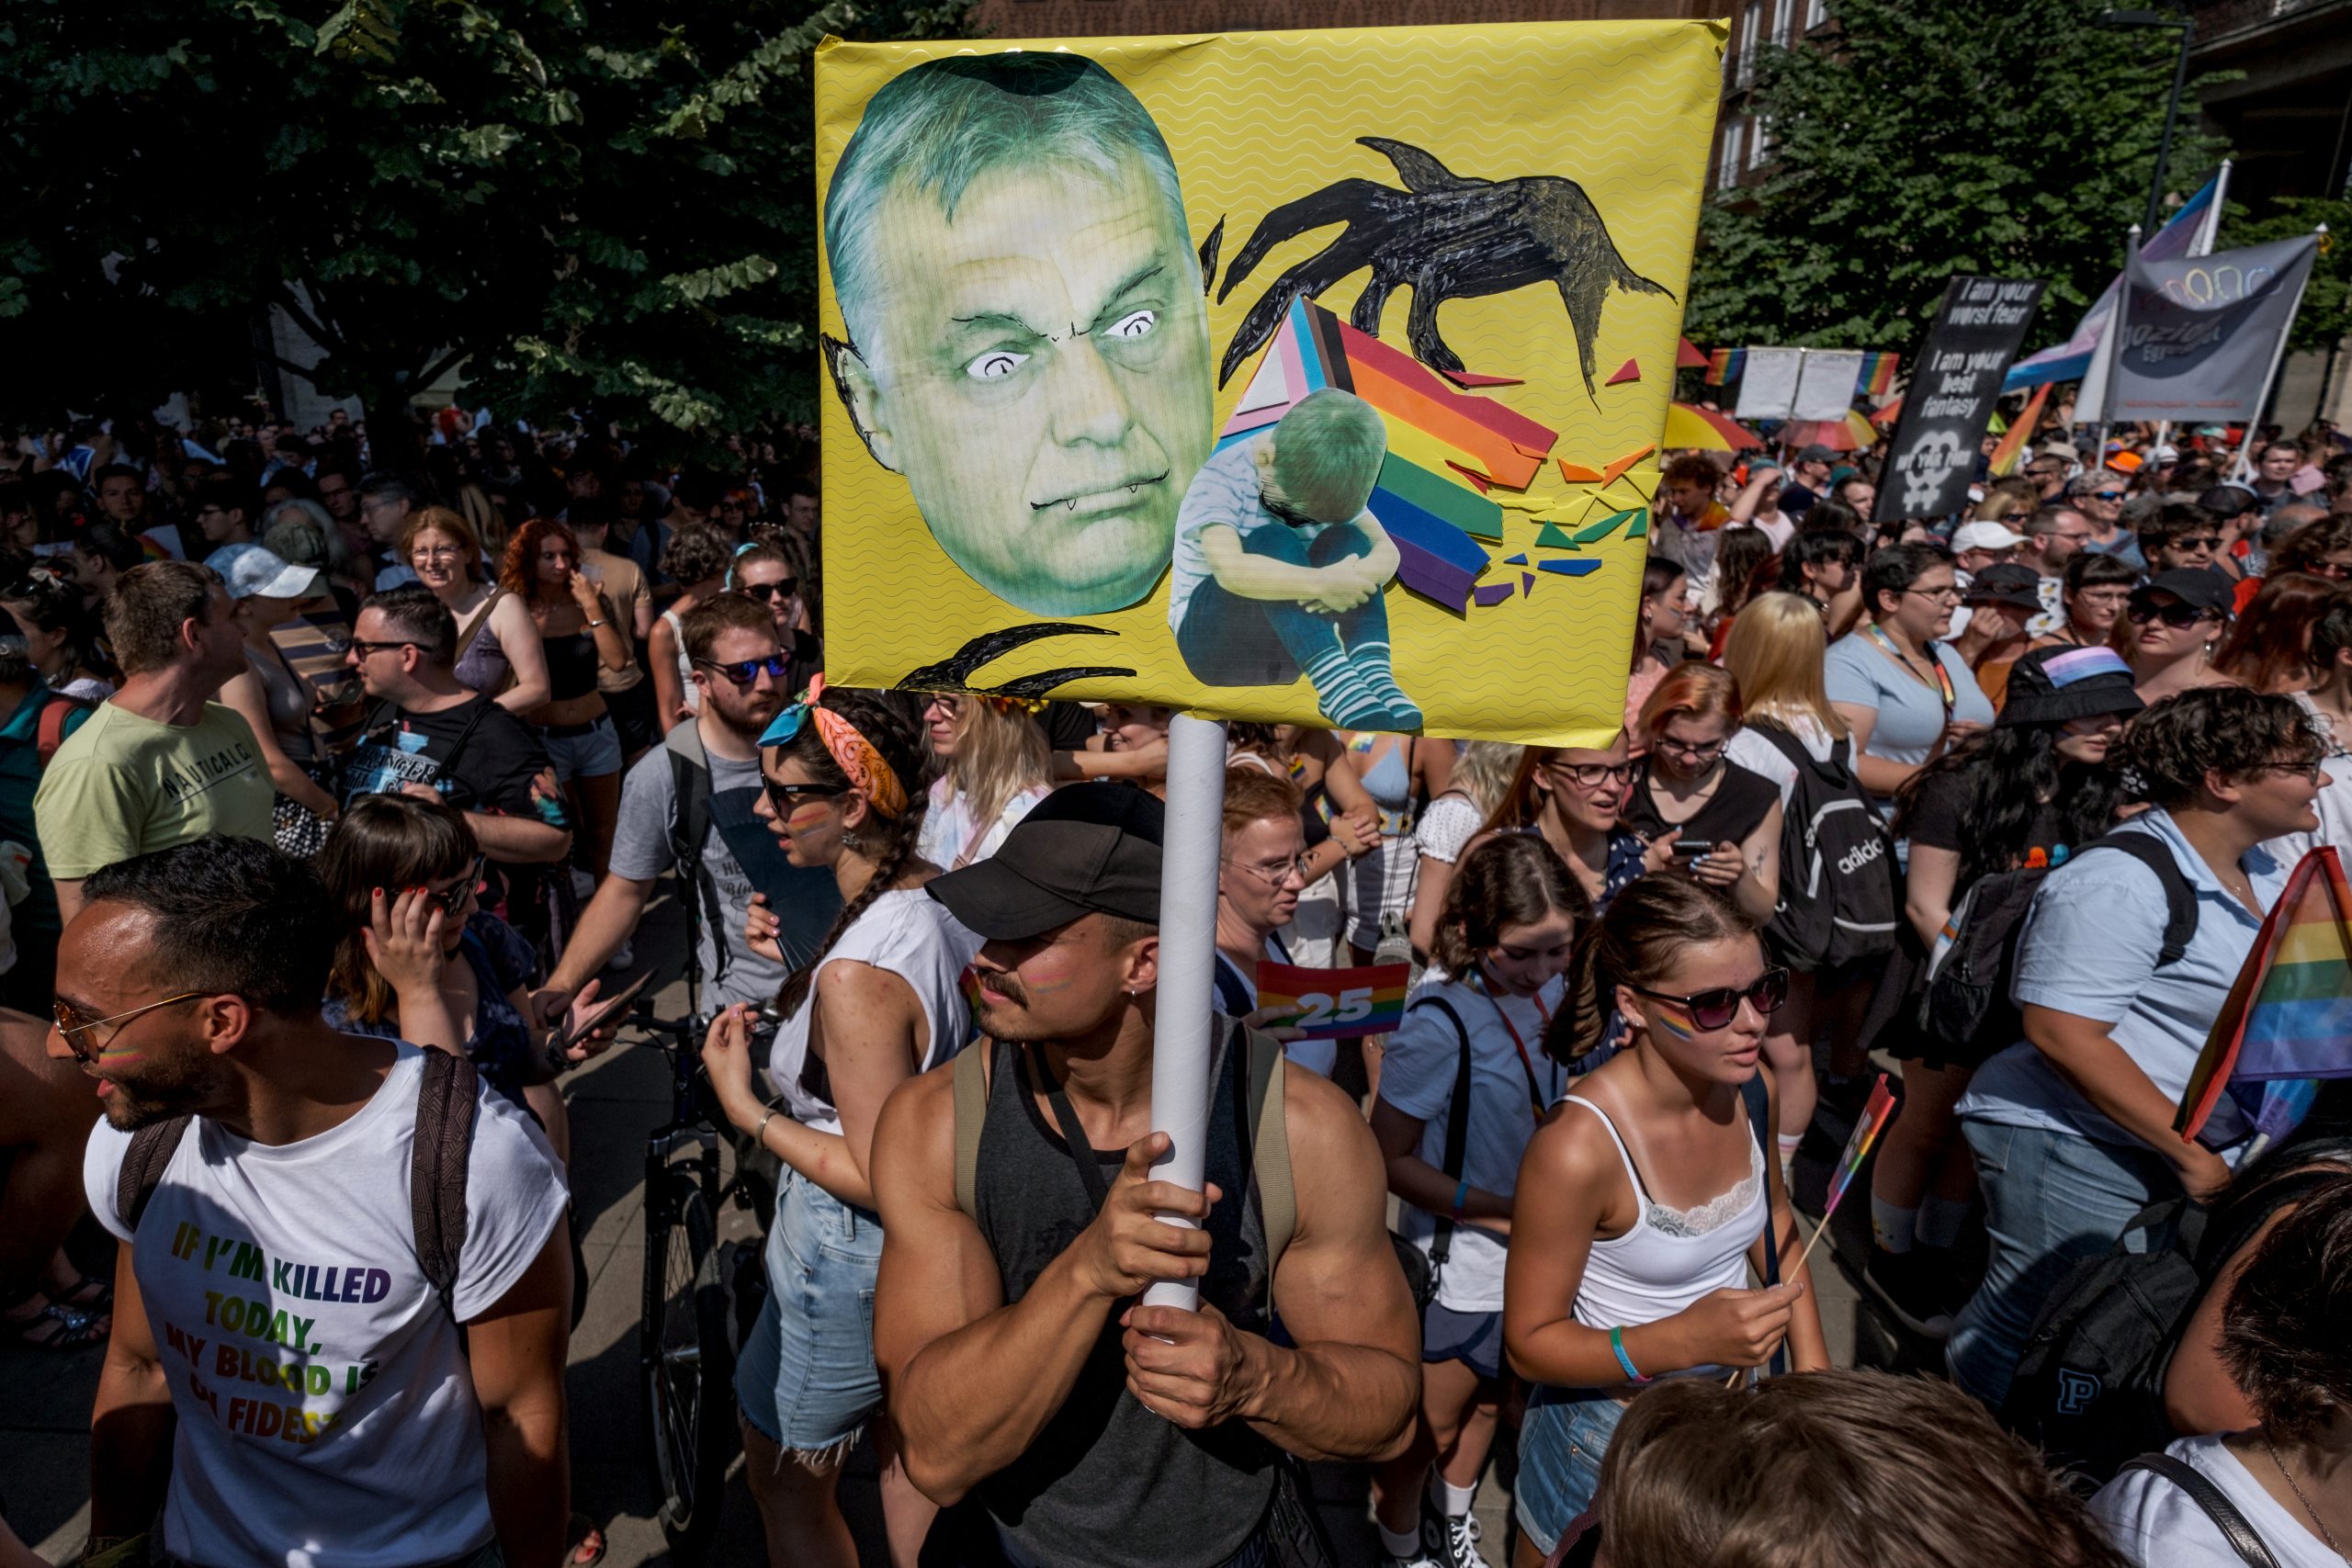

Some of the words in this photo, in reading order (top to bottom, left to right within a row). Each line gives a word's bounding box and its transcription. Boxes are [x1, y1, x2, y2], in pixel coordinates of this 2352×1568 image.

[1961, 278, 1973, 300] I
[1969, 282, 1996, 300] am
[1993, 282, 2037, 307] your
[1948, 304, 1995, 326] worst
[1992, 301, 2030, 324] fear
[1930, 349, 1943, 371] I
[1939, 352, 1965, 371] am
[1963, 351, 2008, 375] your
[1939, 372, 1977, 394] best
[1921, 396, 1981, 419] fantasy
[163, 747, 240, 798] NAUTICAL
[1838, 837, 1884, 874] adida
[1295, 987, 1374, 1027] 25
[172, 1220, 201, 1261] IF
[204, 1235, 265, 1282] I'M
[273, 1257, 391, 1303] KILLED
[206, 1290, 323, 1356] TODAY,
[165, 1321, 207, 1368] MY
[216, 1344, 332, 1396] BLOOD
[345, 1360, 379, 1396] IS
[2058, 1367, 2101, 1415] P
